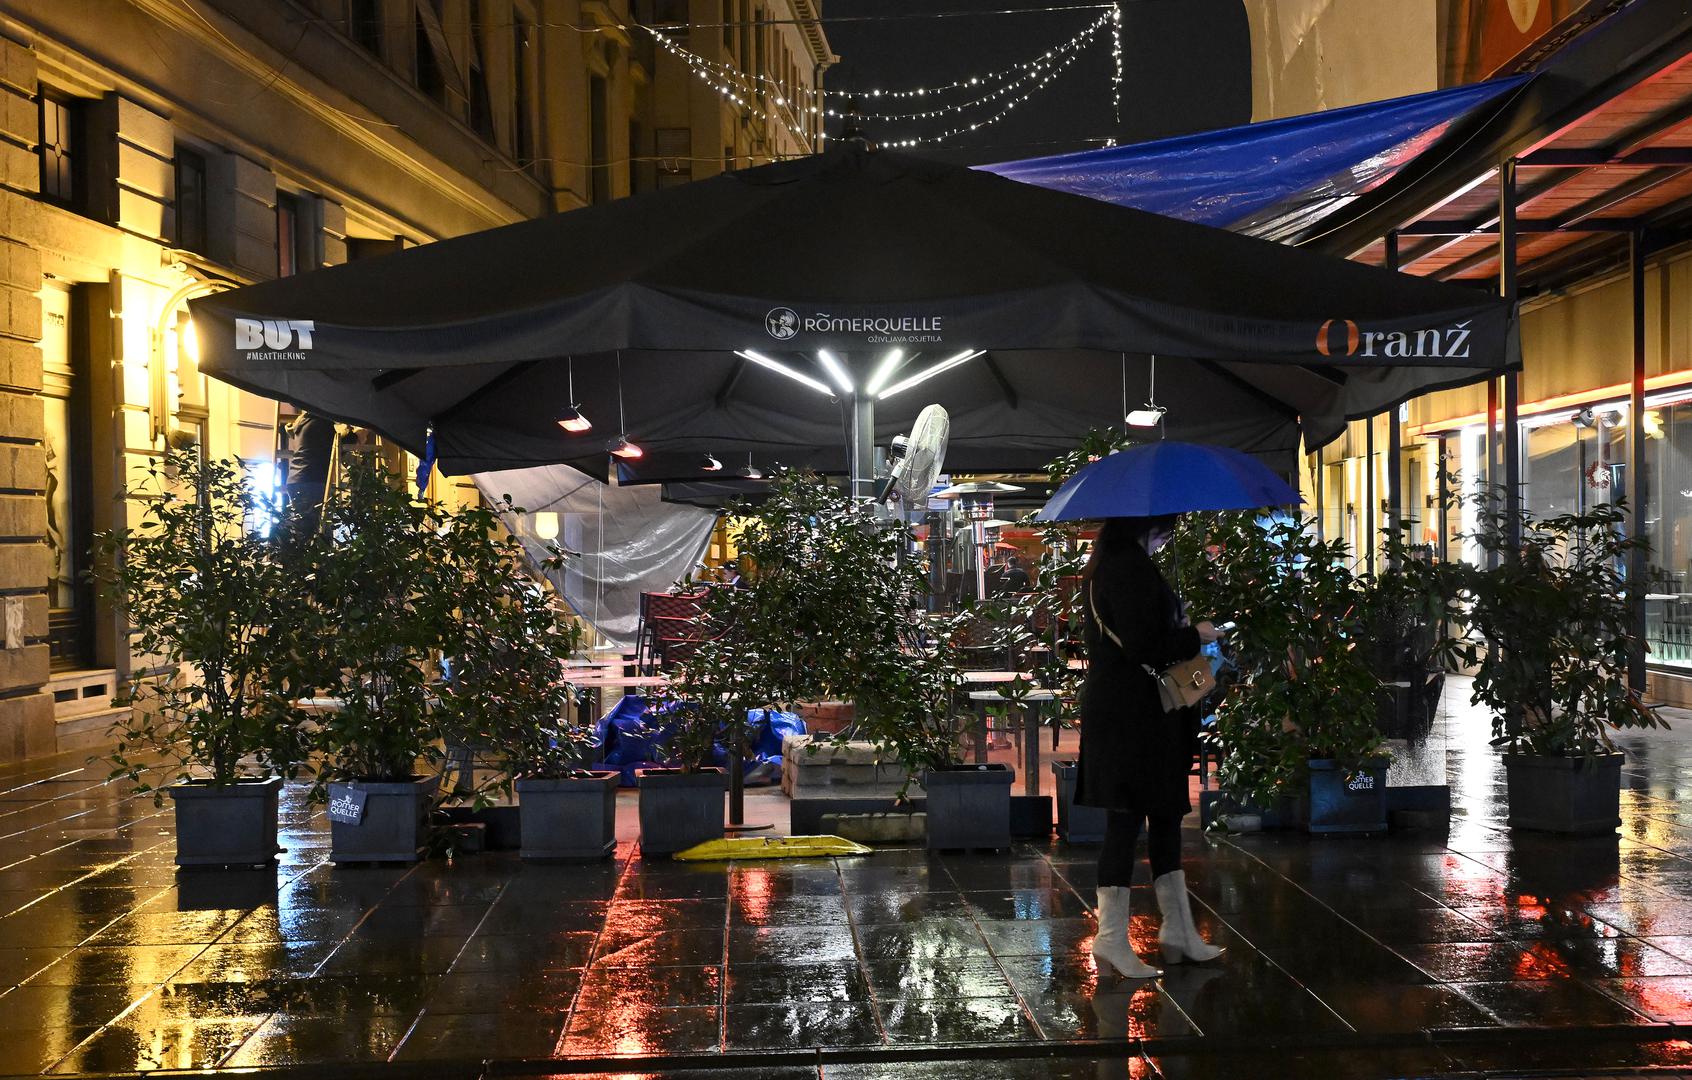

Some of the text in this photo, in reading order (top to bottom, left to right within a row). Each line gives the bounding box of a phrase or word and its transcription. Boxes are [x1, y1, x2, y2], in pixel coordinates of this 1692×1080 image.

[235, 318, 315, 350] BUT
[867, 335, 943, 343] OŽIVLJAVA OSJETILA
[1315, 319, 1473, 358] Oranž
[1348, 782, 1374, 791] QUELLE
[330, 806, 358, 818] QUELLE
